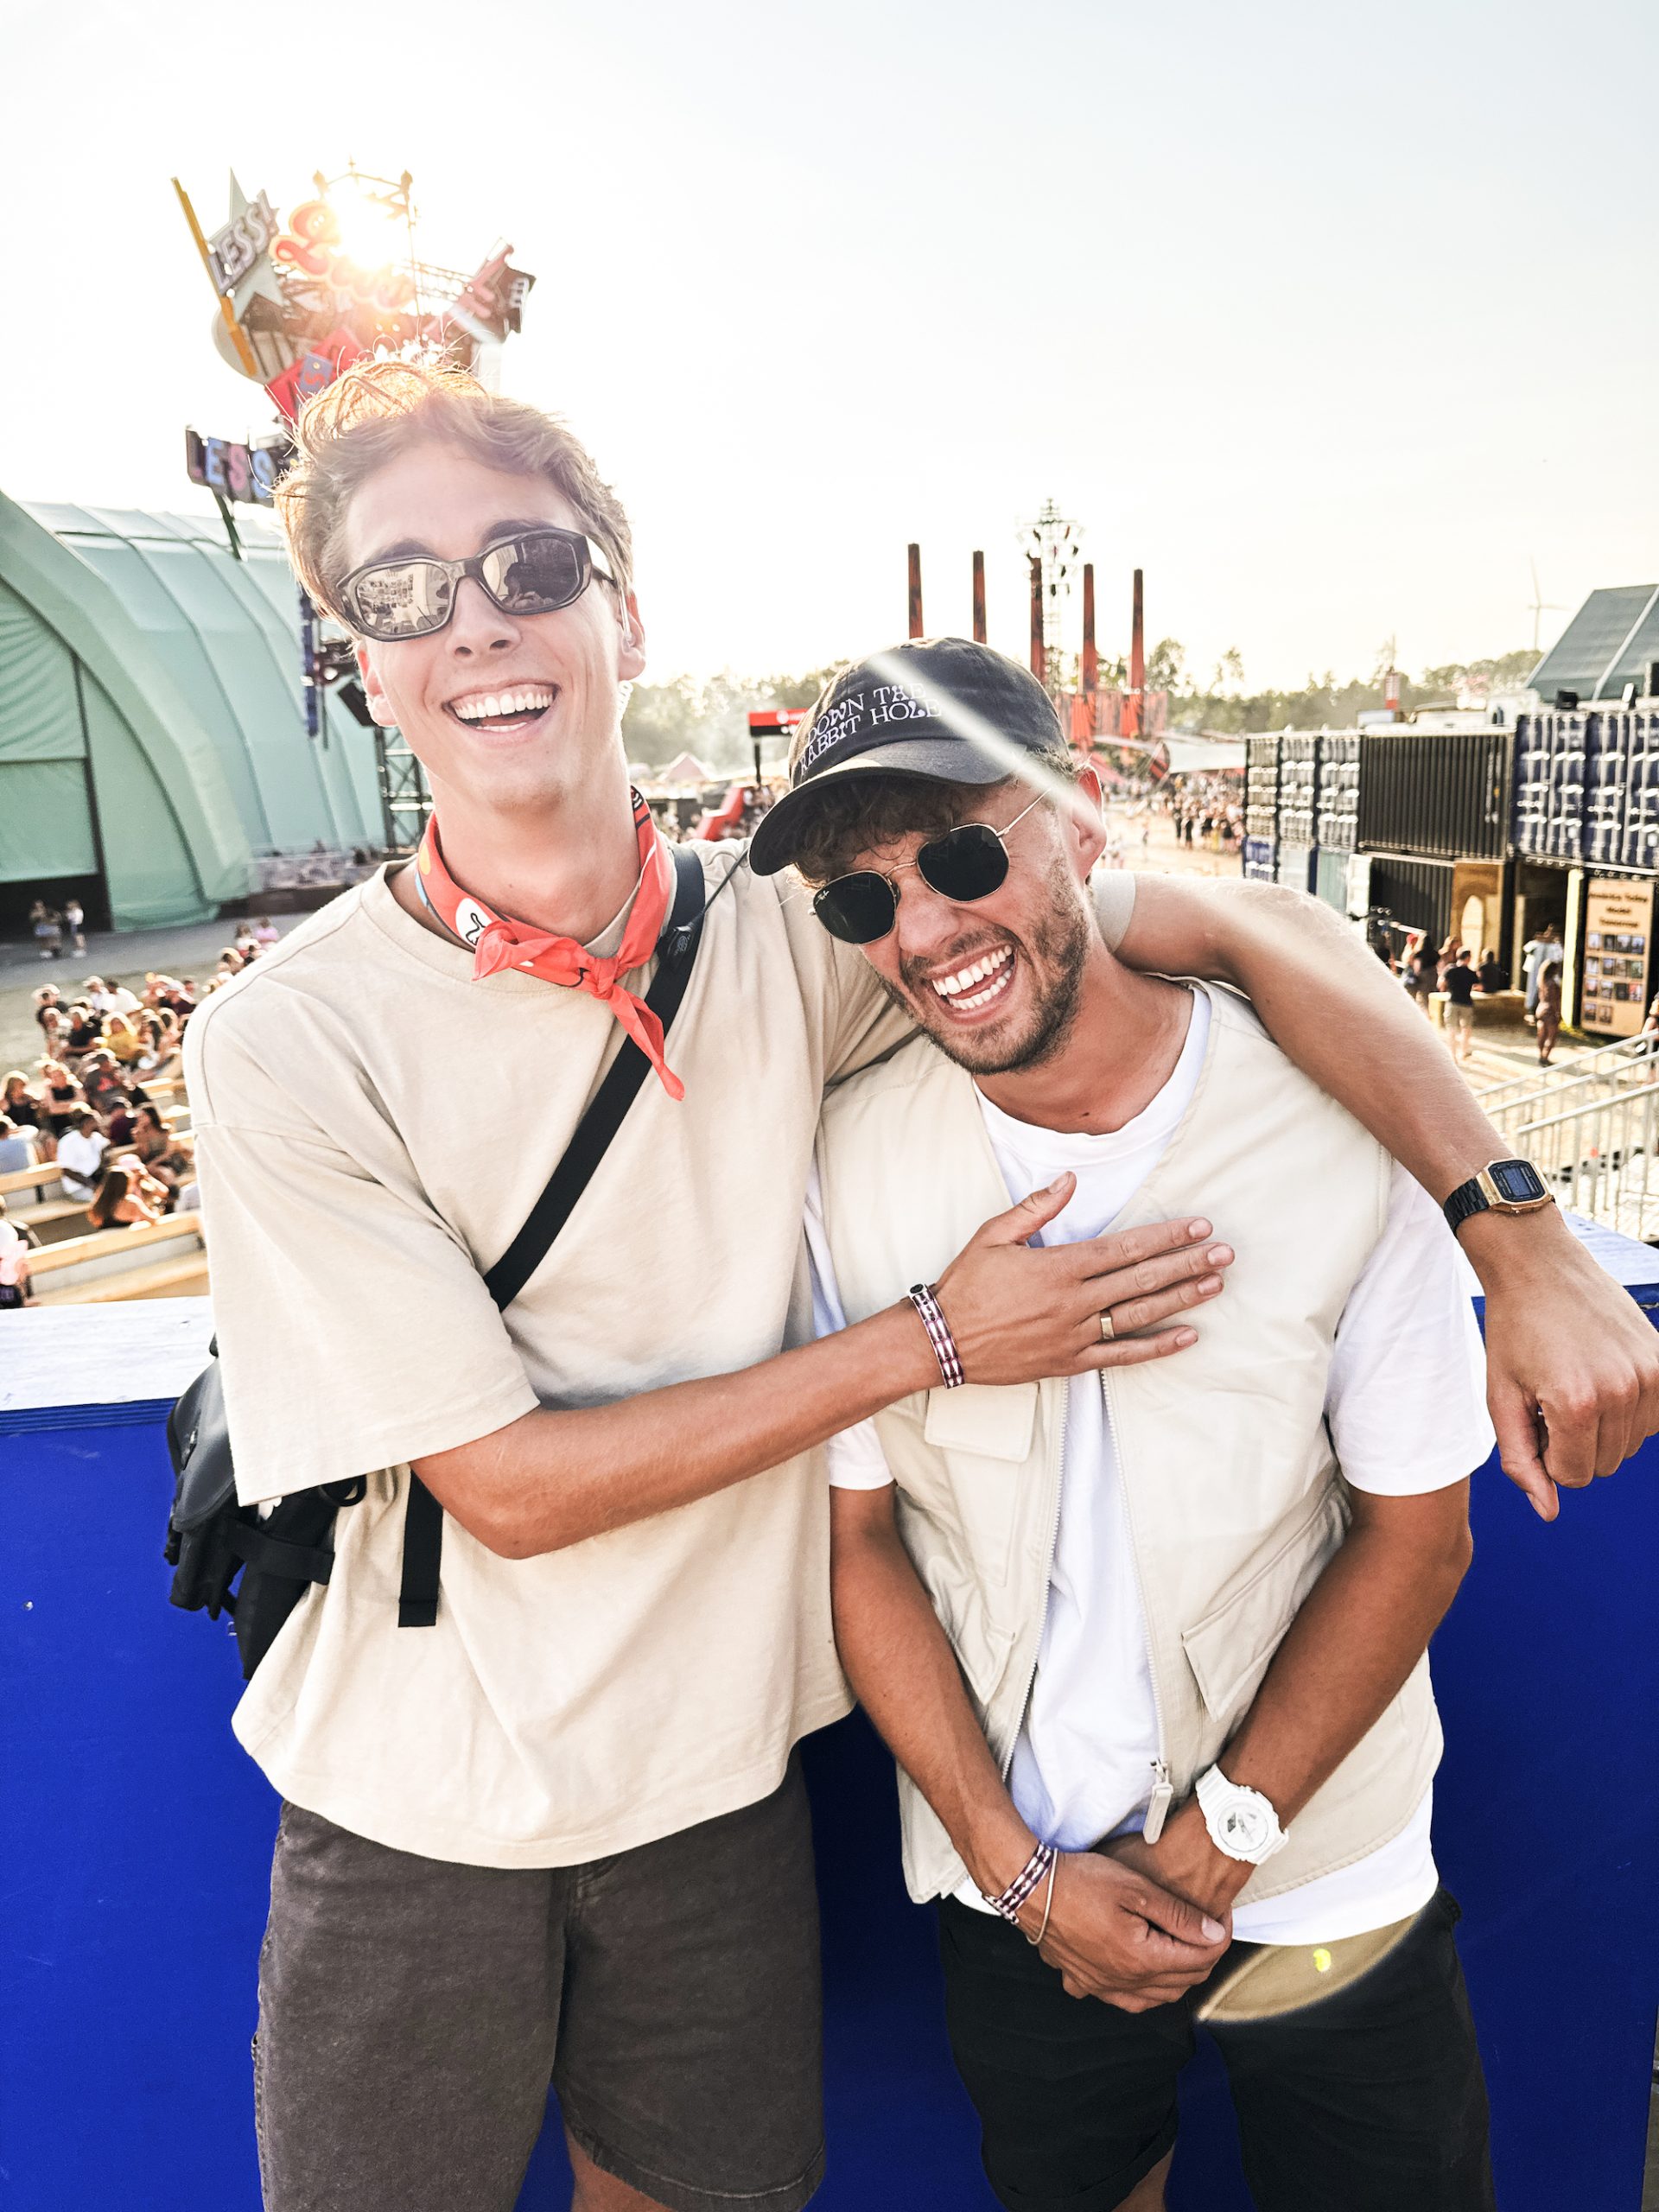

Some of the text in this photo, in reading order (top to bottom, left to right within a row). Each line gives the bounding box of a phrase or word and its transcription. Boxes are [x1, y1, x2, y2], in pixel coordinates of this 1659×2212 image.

[191, 436, 274, 499] ESS
[800, 699, 941, 775] RABBIT HOLE
[807, 683, 927, 747] DOWN THE
